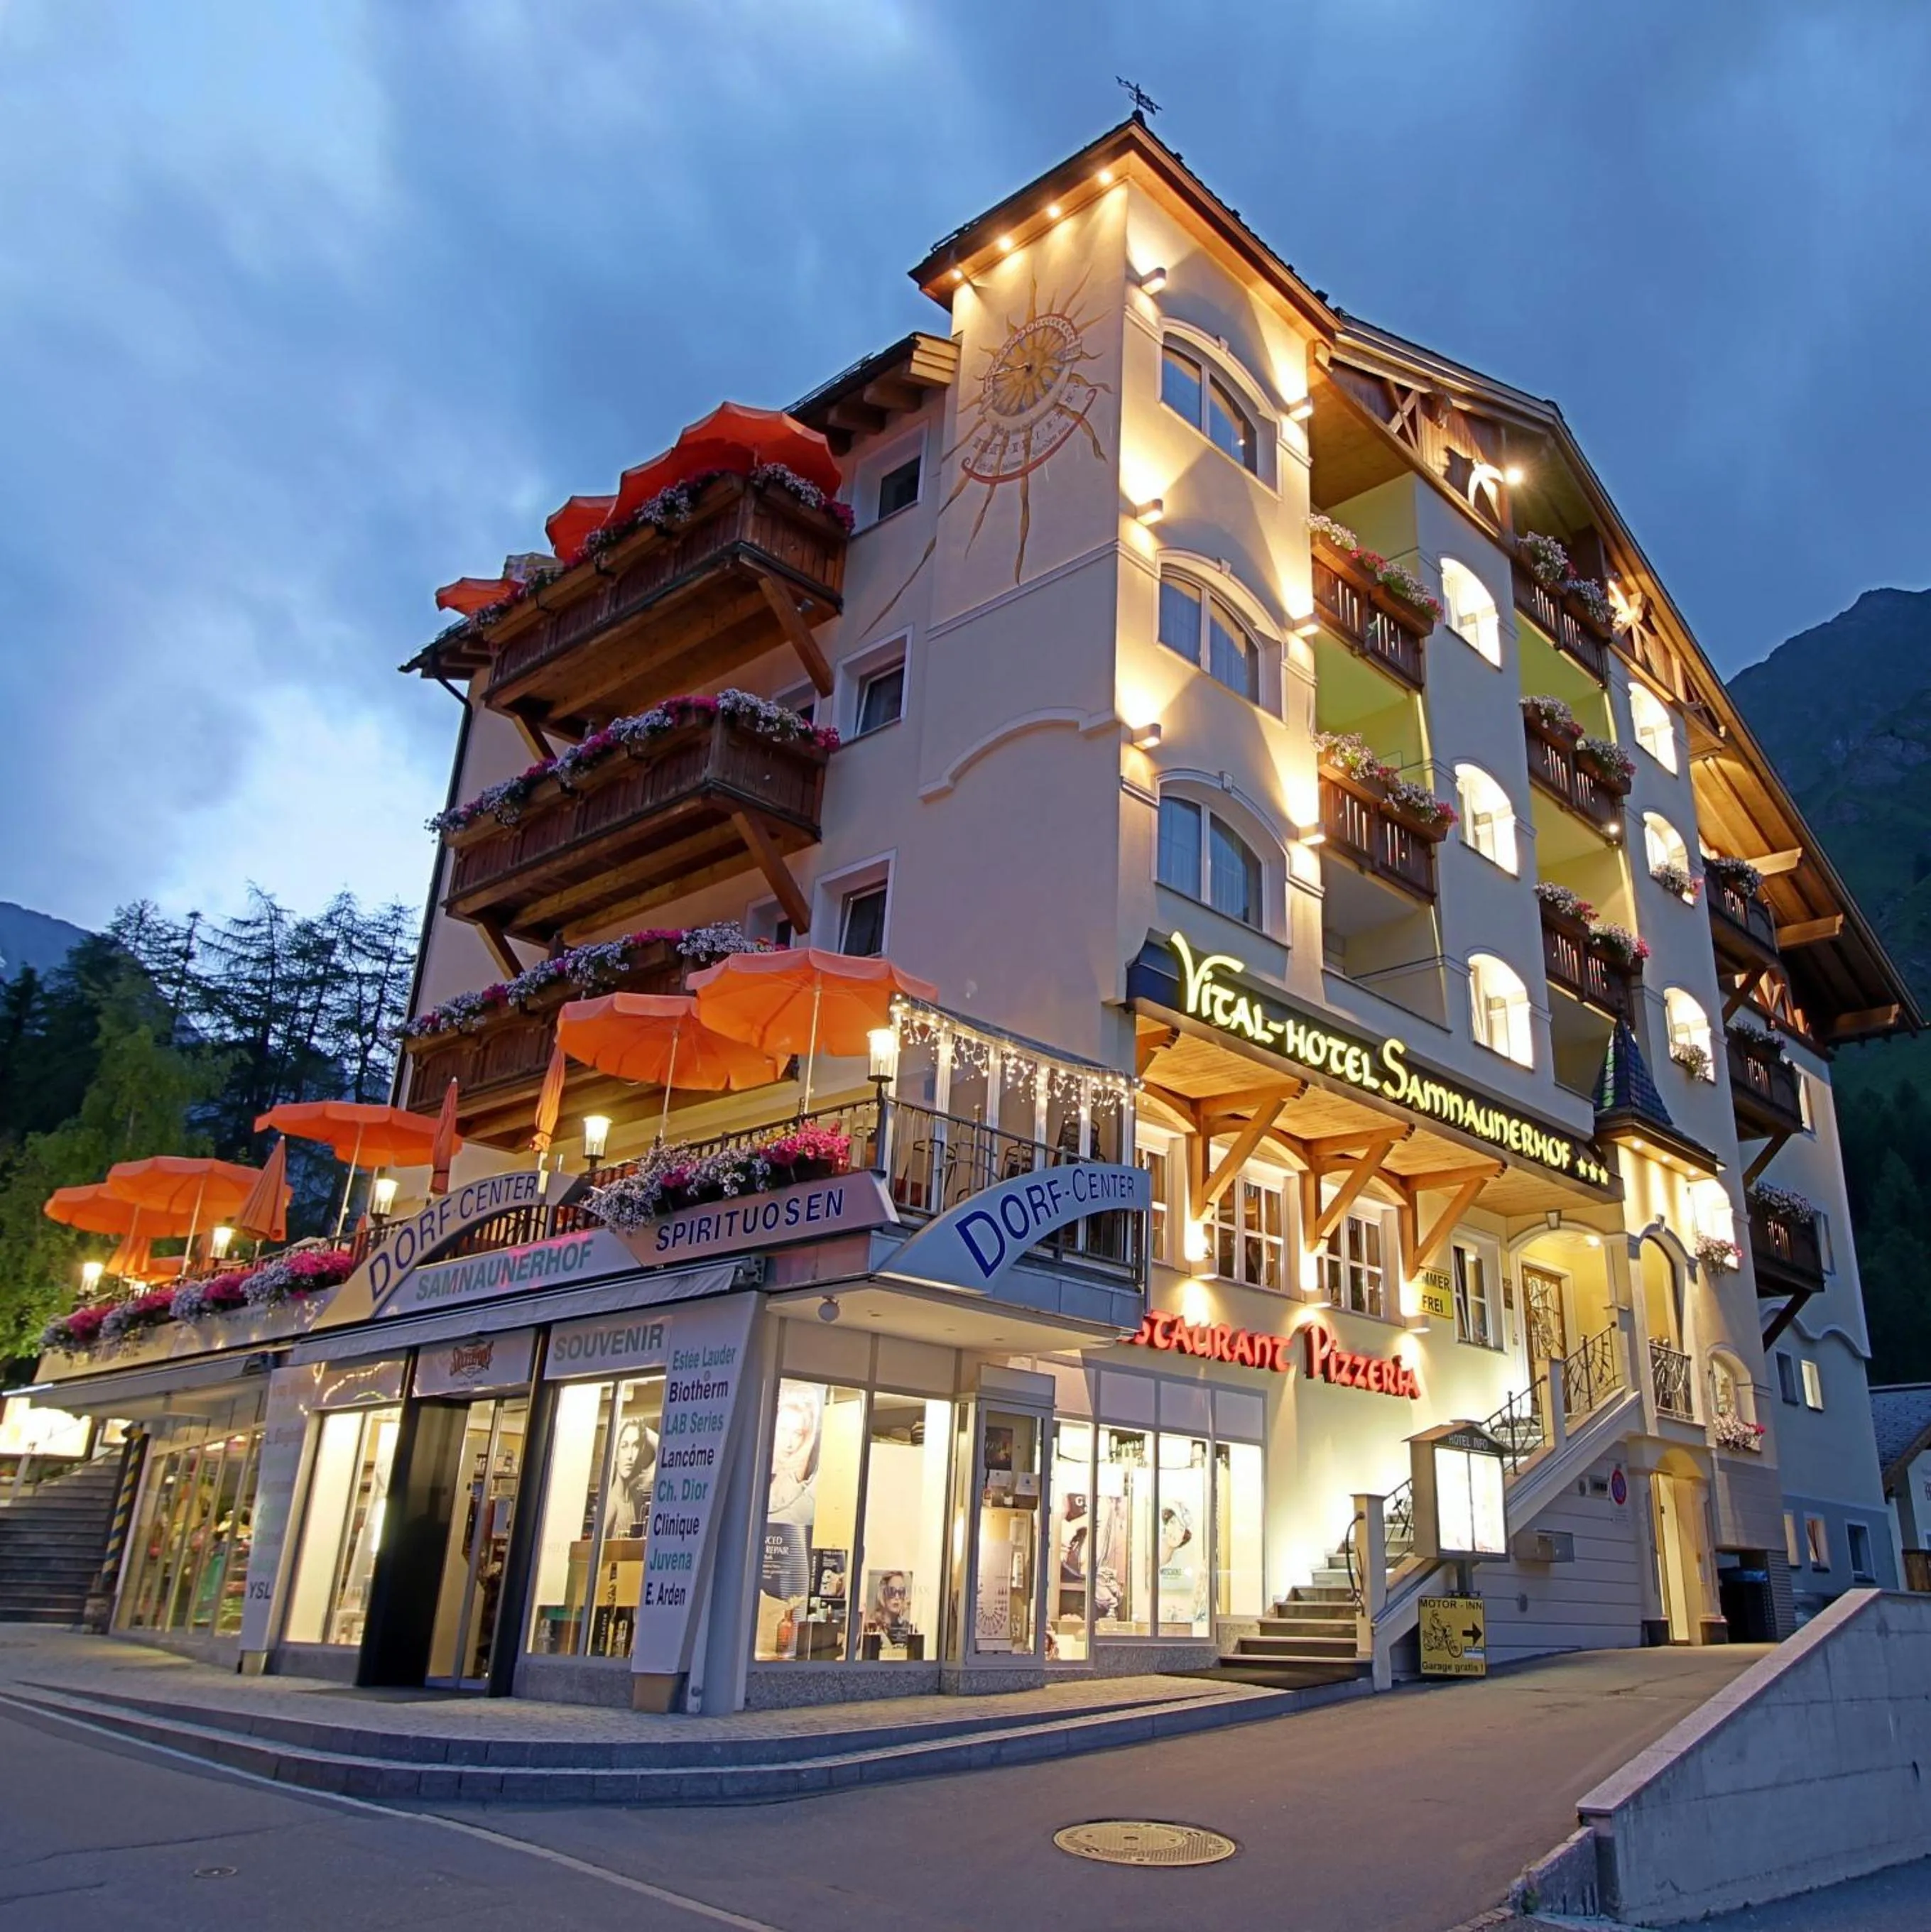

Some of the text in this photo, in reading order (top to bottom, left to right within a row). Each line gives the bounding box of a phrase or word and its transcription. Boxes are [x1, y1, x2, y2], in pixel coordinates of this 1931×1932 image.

[655, 1189, 845, 1252] SPIRITUOSEN
[415, 1240, 594, 1301] SAMNAUNERHOF
[1423, 1294, 1444, 1313] FREI
[553, 1324, 664, 1362] SOUVENIR
[702, 1343, 736, 1368] Lauder
[668, 1379, 729, 1403] Biotherm
[665, 1410, 724, 1436] LAB Series
[1448, 1434, 1489, 1450] HOTEL INFO
[658, 1478, 709, 1502] Ch. Dior
[653, 1512, 700, 1541] Clinique
[649, 1548, 692, 1571] Juvena
[249, 1581, 272, 1600] YSL
[656, 1581, 686, 1605] Arden
[1420, 1598, 1457, 1609] MOTOR
[1465, 1600, 1483, 1610] INN
[1422, 1661, 1453, 1673] Garage
